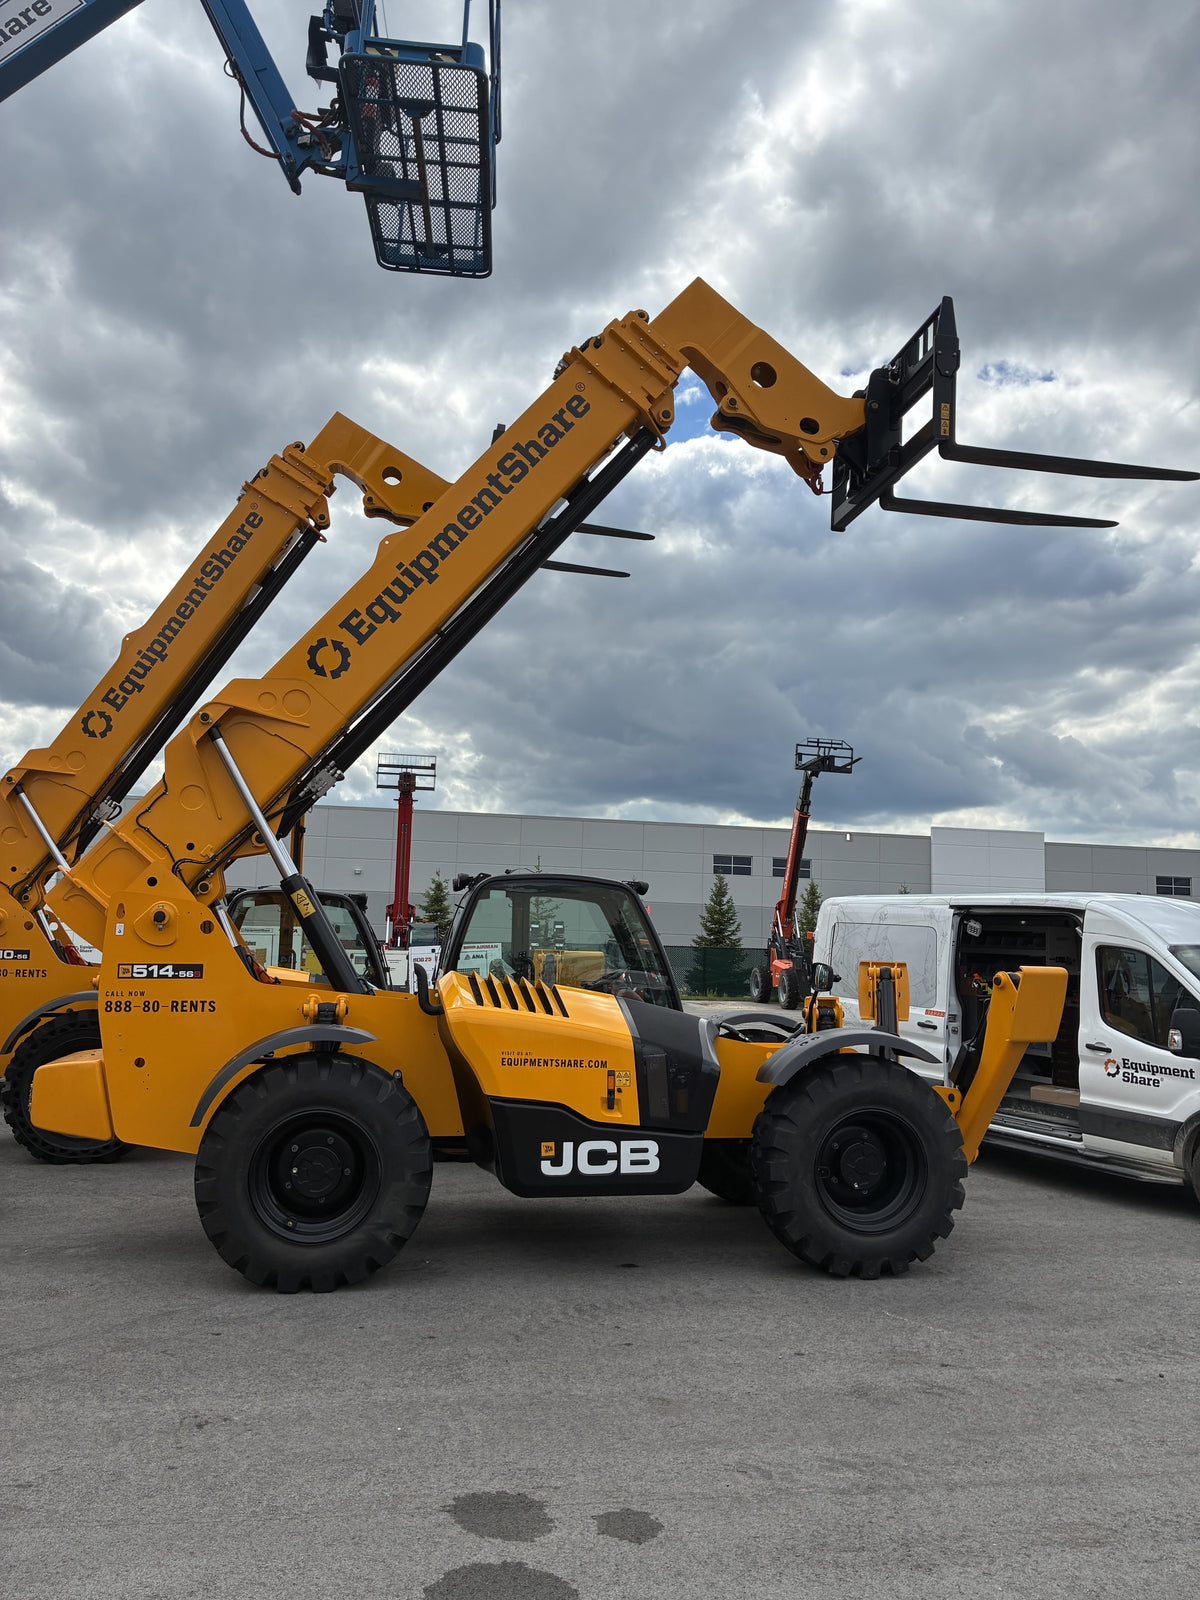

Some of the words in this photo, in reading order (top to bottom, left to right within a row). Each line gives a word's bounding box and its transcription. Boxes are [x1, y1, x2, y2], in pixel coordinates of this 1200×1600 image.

[338, 394, 590, 646] EquipmentShare
[101, 511, 264, 712] EquipmentShare
[0, 968, 47, 978] 0-RENTS
[104, 1000, 216, 1013] 888-80-RENTS
[501, 1057, 608, 1069] EQUIPMENTSHARE.COM
[1121, 1057, 1196, 1079] Equipment
[1121, 1071, 1160, 1087] Share
[540, 1140, 660, 1176] JCB
